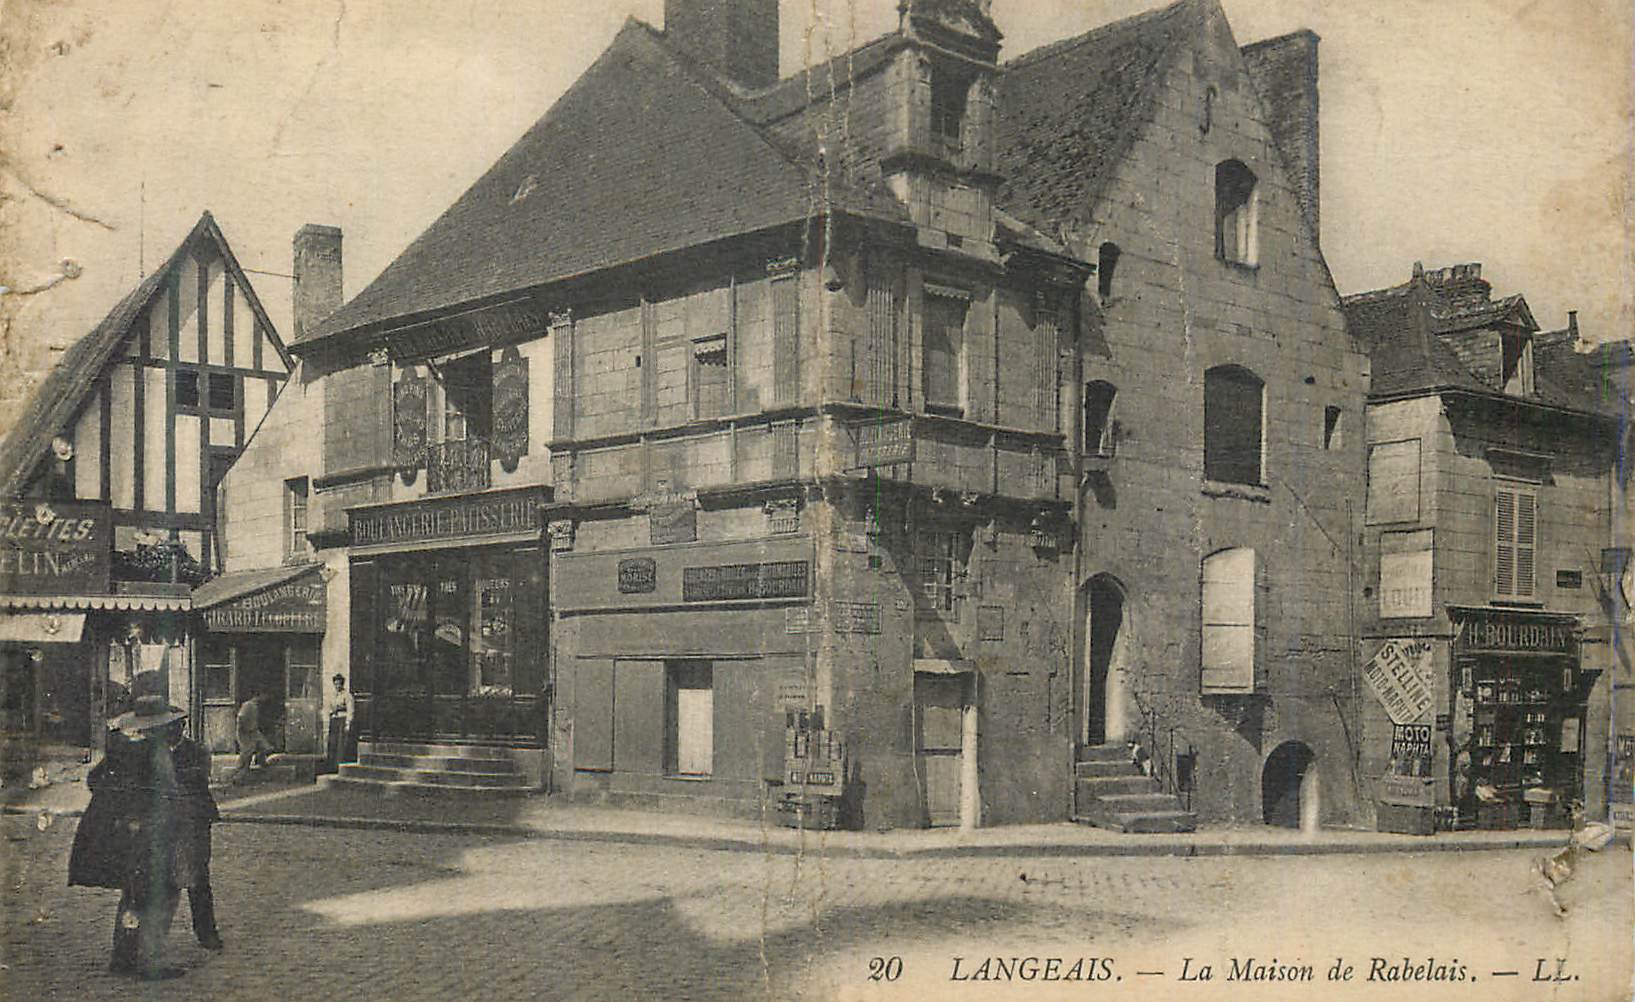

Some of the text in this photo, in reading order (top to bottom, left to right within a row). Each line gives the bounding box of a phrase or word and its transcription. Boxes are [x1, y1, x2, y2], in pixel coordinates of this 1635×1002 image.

[1486, 622, 1567, 648] BOURDAIN
[1381, 644, 1431, 711] STELLINE
[1394, 725, 1431, 742] MOTO
